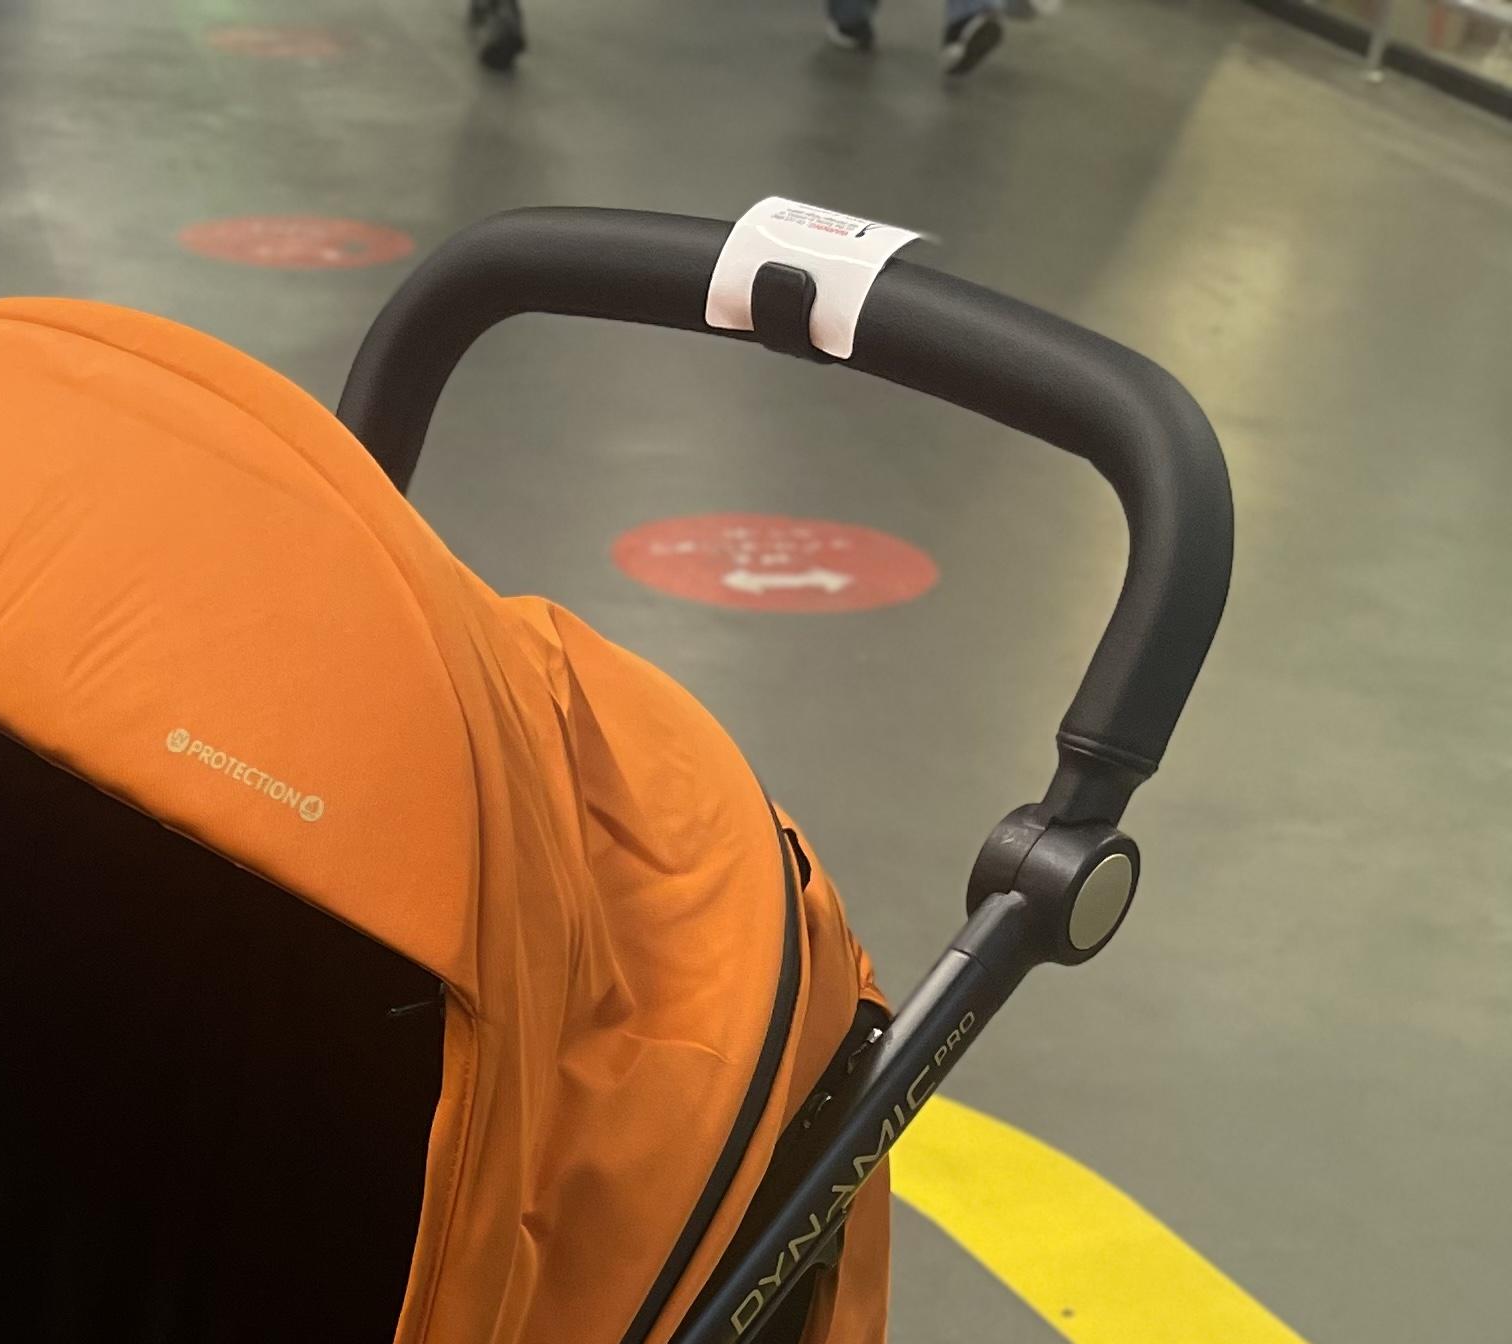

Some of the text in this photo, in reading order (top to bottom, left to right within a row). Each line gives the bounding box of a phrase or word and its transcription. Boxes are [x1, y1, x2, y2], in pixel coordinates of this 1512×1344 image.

[188, 739, 302, 809] PROTECTION
[730, 1010, 976, 1336] DYNAMIC PRO
